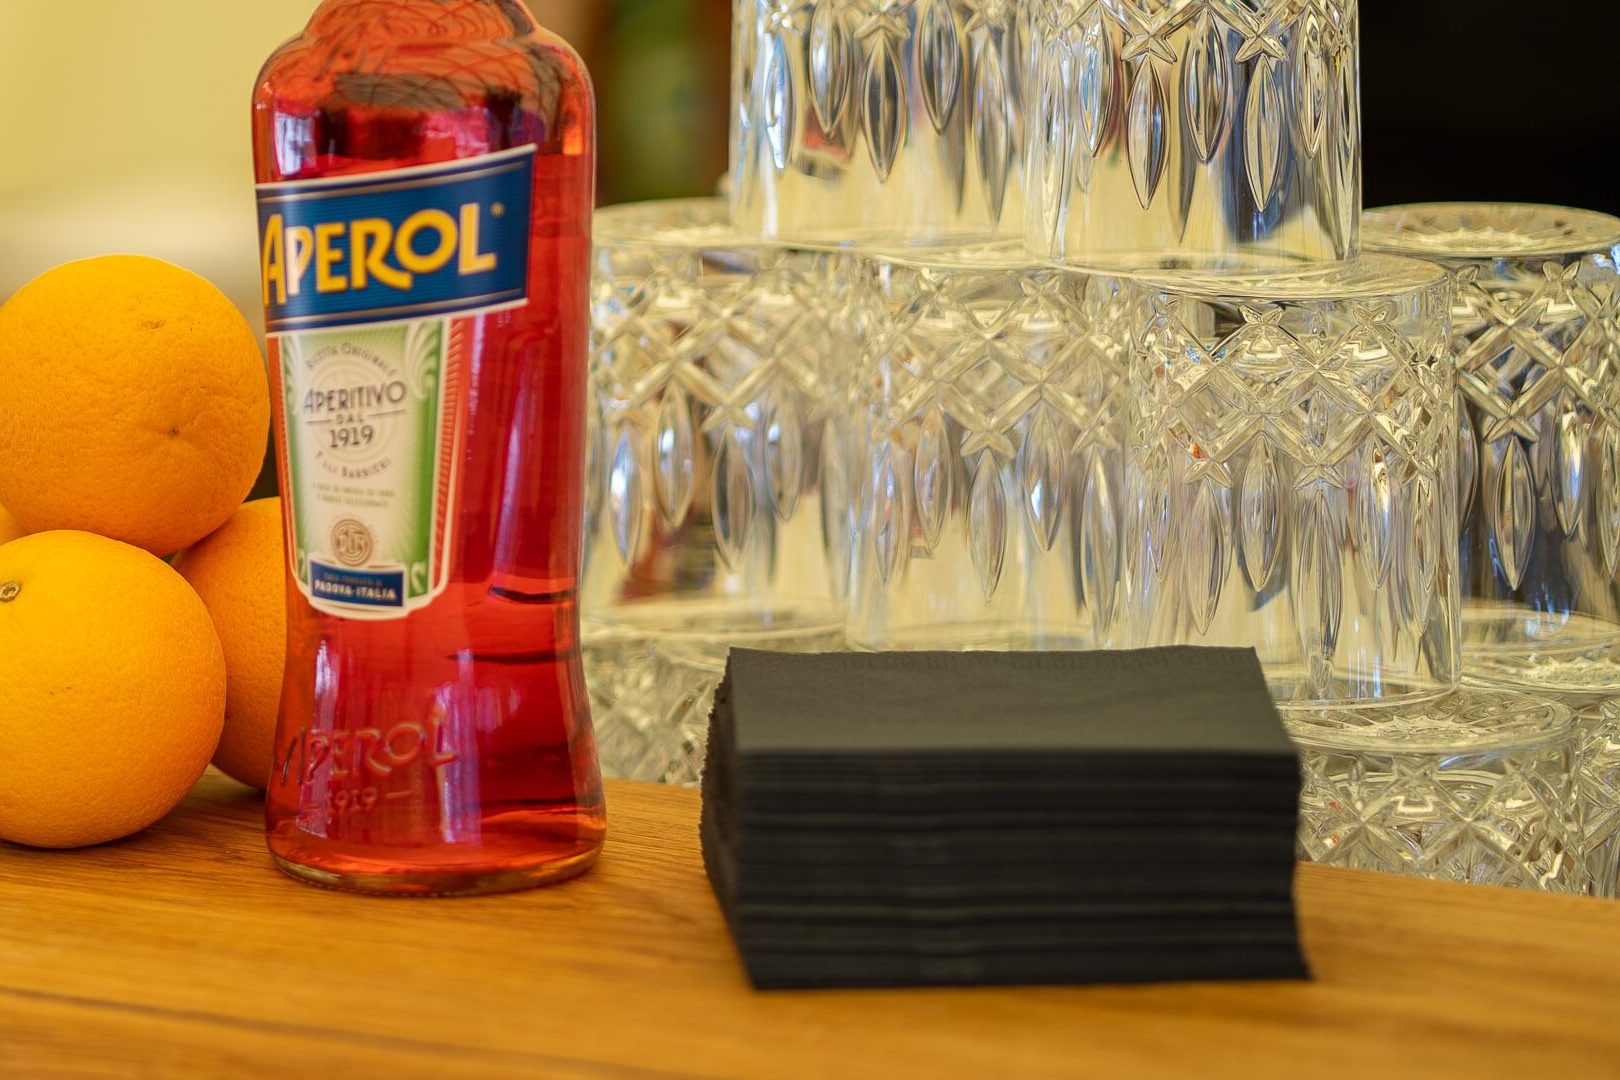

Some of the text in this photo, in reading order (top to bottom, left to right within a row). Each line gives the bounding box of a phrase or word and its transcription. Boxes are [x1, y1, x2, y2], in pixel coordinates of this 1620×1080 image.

[263, 202, 498, 306] APEROL
[303, 381, 407, 414] APERITIVO
[330, 424, 375, 448] 1919
